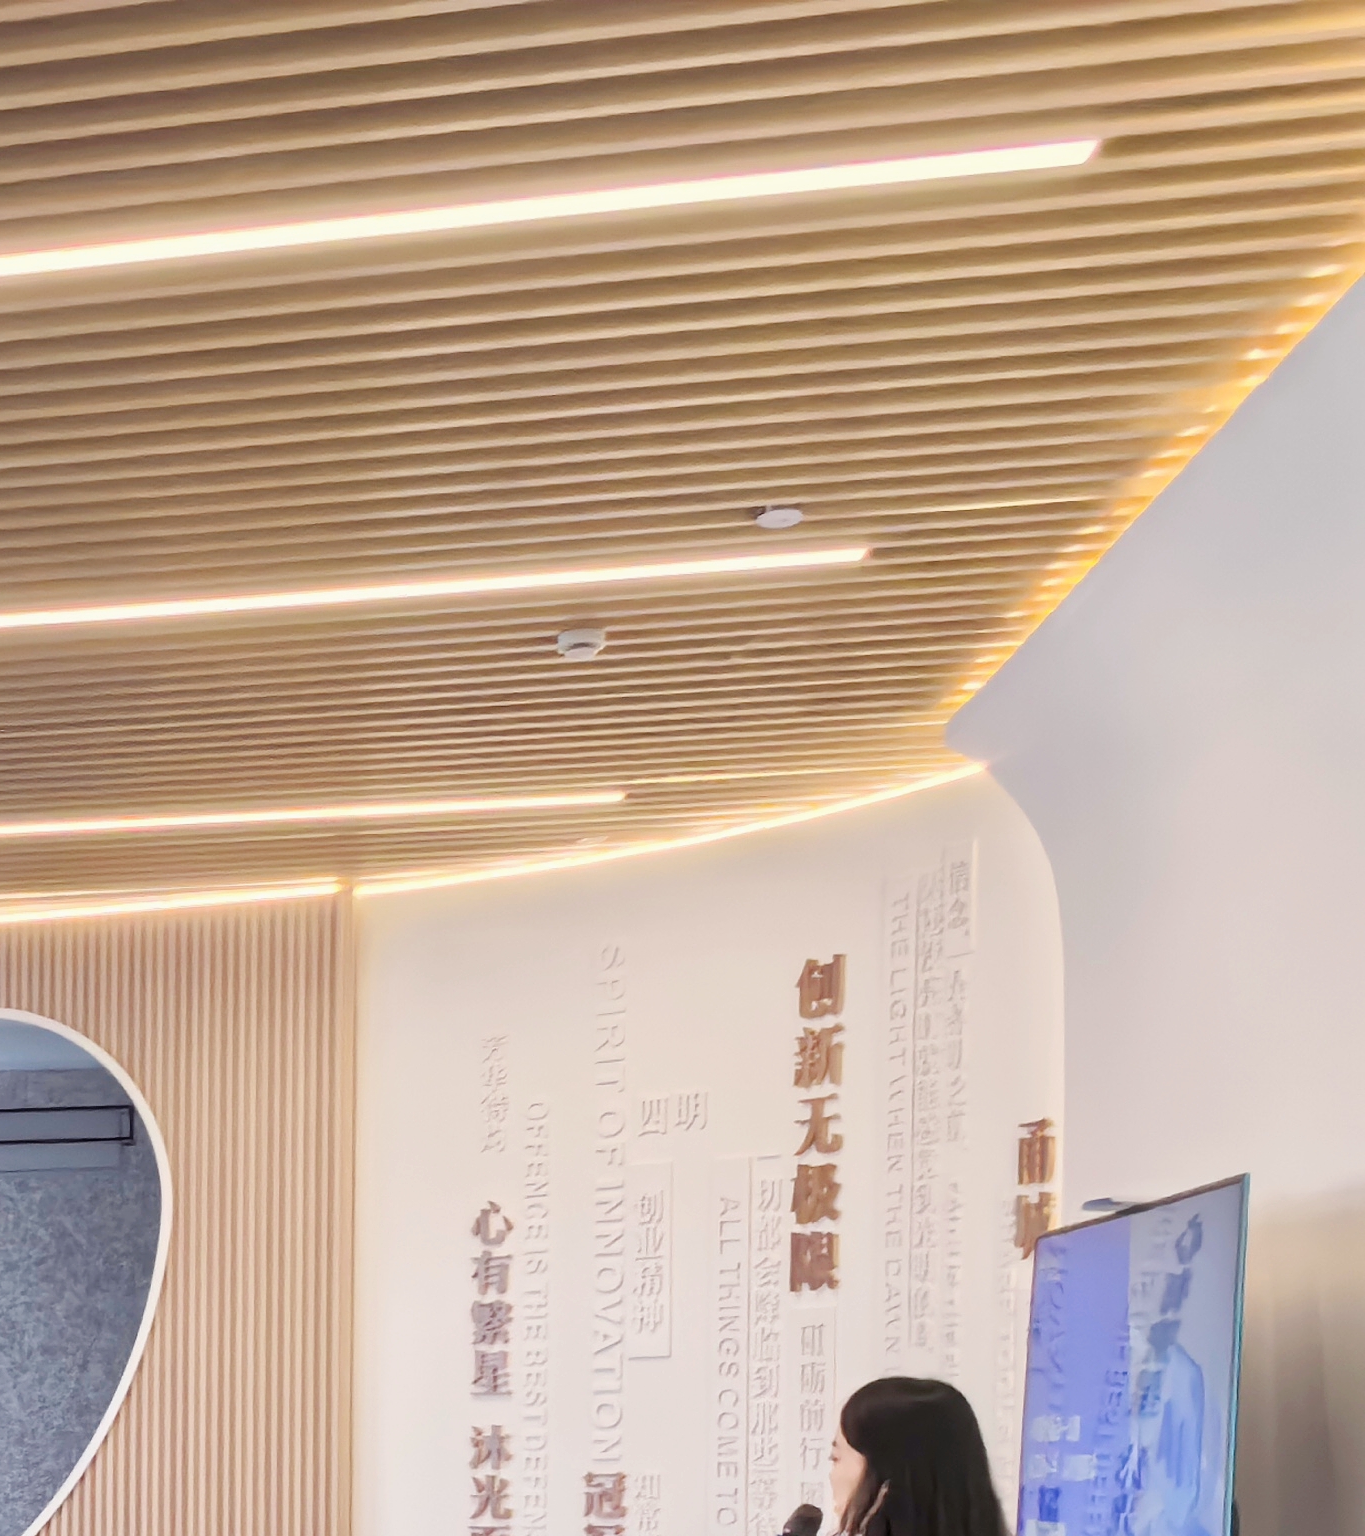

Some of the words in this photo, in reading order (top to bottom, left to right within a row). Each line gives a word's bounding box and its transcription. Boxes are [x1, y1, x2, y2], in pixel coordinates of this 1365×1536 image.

[888, 891, 910, 959] THE
[594, 944, 626, 1094] SPIRIT
[888, 967, 907, 1066] LIGHT
[594, 1110, 626, 1168] OF
[789, 953, 847, 1293] 创新无极限
[886, 1074, 907, 1173] WHEN
[523, 1101, 549, 1241] OFFENCE
[885, 1183, 905, 1249] THE
[524, 1250, 549, 1276] IS
[718, 1196, 741, 1255] ALL
[470, 1200, 514, 1397] 心有繁星
[523, 1283, 548, 1341] THE
[592, 1184, 625, 1464] INNOVATION
[717, 1262, 740, 1380] THINGS
[522, 1350, 548, 1427] BEST
[716, 1388, 740, 1479] COME
[715, 1487, 739, 1528] TO
